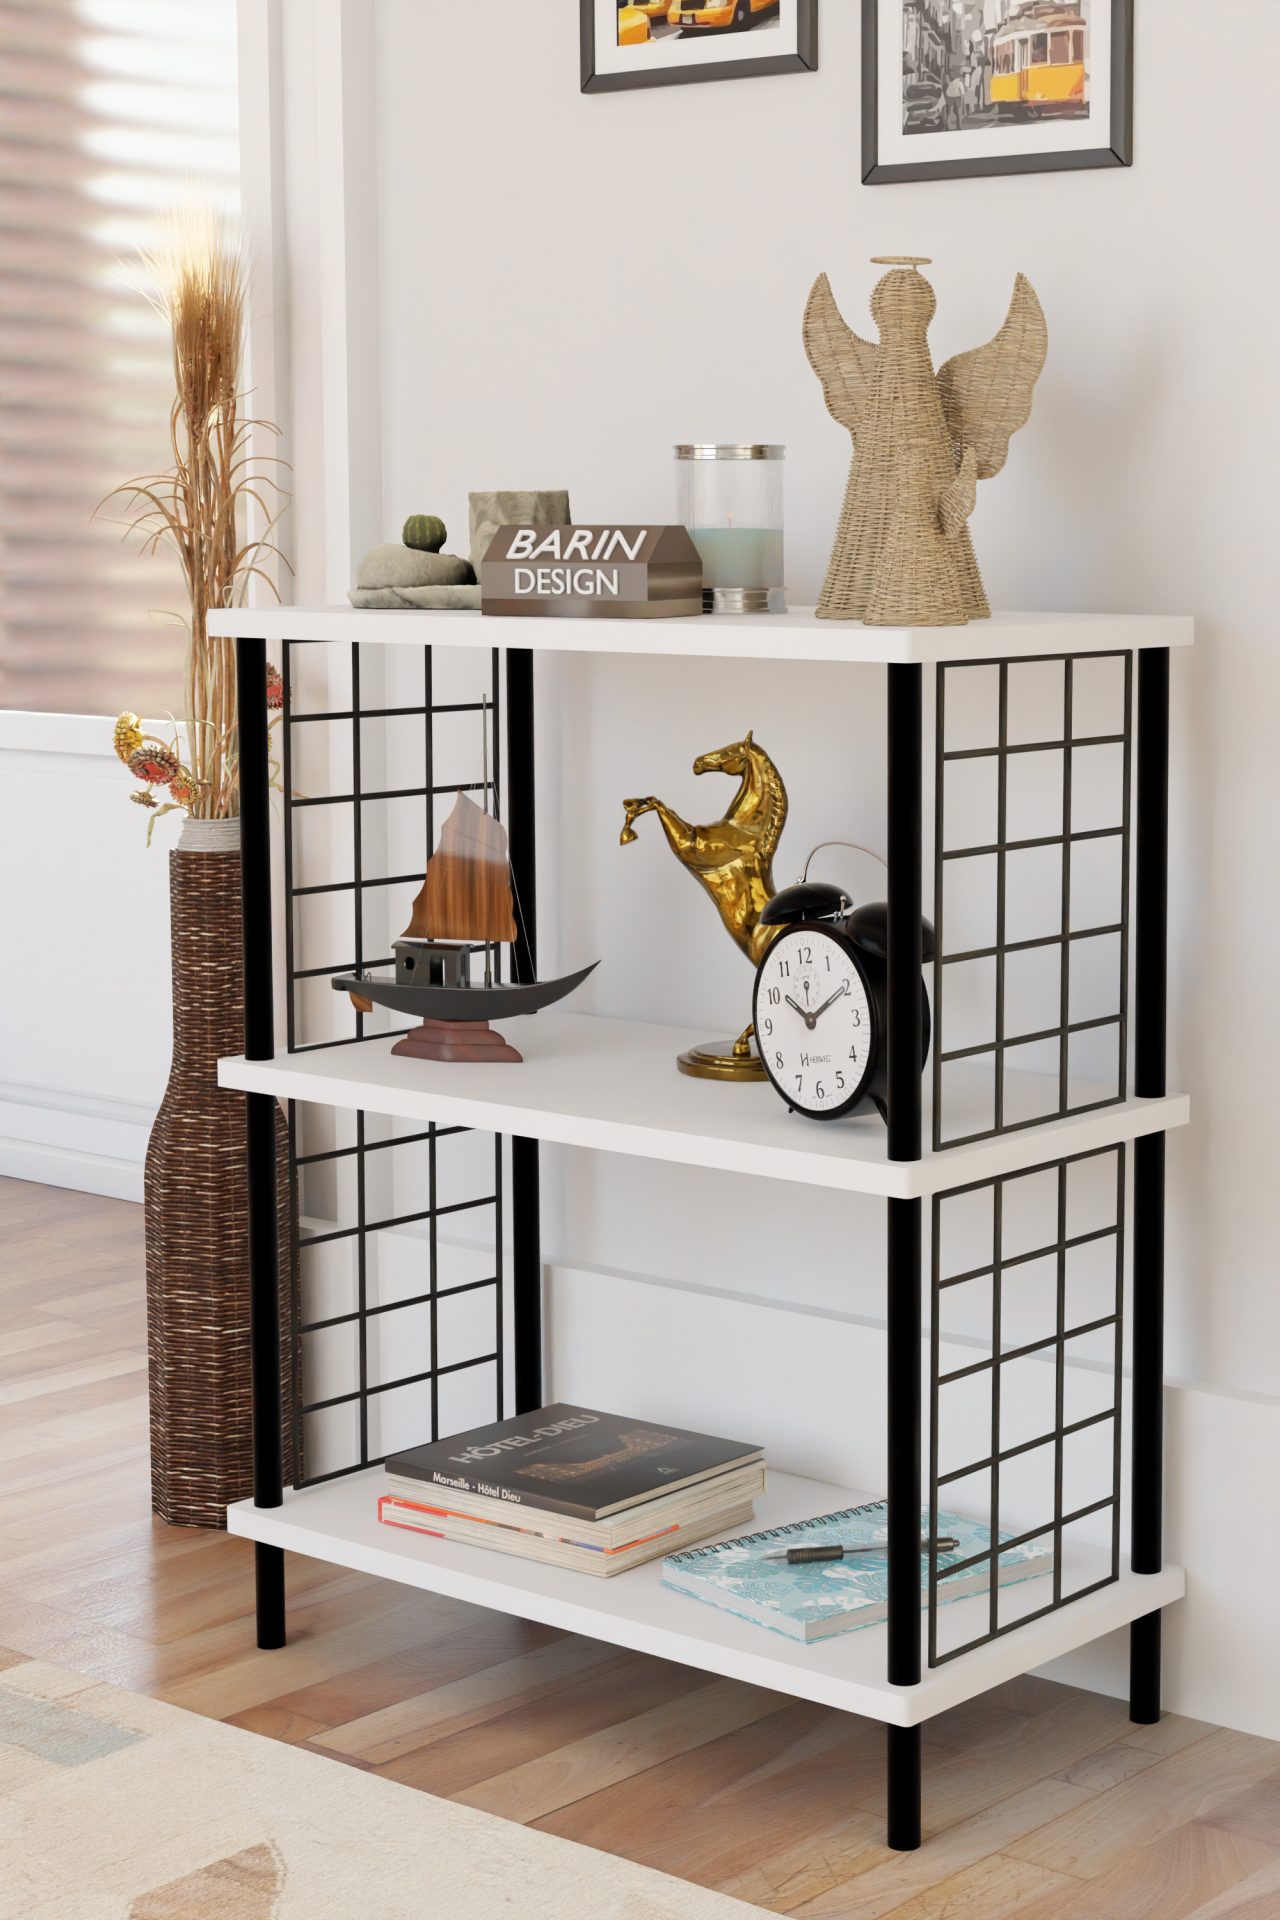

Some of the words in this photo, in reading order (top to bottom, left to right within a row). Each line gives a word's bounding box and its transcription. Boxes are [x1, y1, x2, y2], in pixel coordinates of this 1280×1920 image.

[505, 529, 648, 561] BARIN
[514, 568, 619, 596] DESIGN
[797, 946, 812, 965] 12
[825, 955, 831, 972] 1
[779, 960, 790, 978] 11
[767, 986, 781, 1005] 10
[842, 978, 852, 997] 2
[764, 1018, 773, 1036] 9
[851, 1008, 861, 1028] 3
[775, 1051, 784, 1070] 8
[809, 1054, 831, 1064] HERWEG
[848, 1044, 858, 1063] 4
[795, 1074, 803, 1093] 7
[835, 1070, 845, 1089] 5
[815, 1080, 825, 1099] 6
[448, 1414, 600, 1464] HÔTEL-DIEU
[433, 1471, 470, 1491] Marseille
[477, 1482, 500, 1498] Hôtel
[501, 1488, 521, 1503] Dieu
